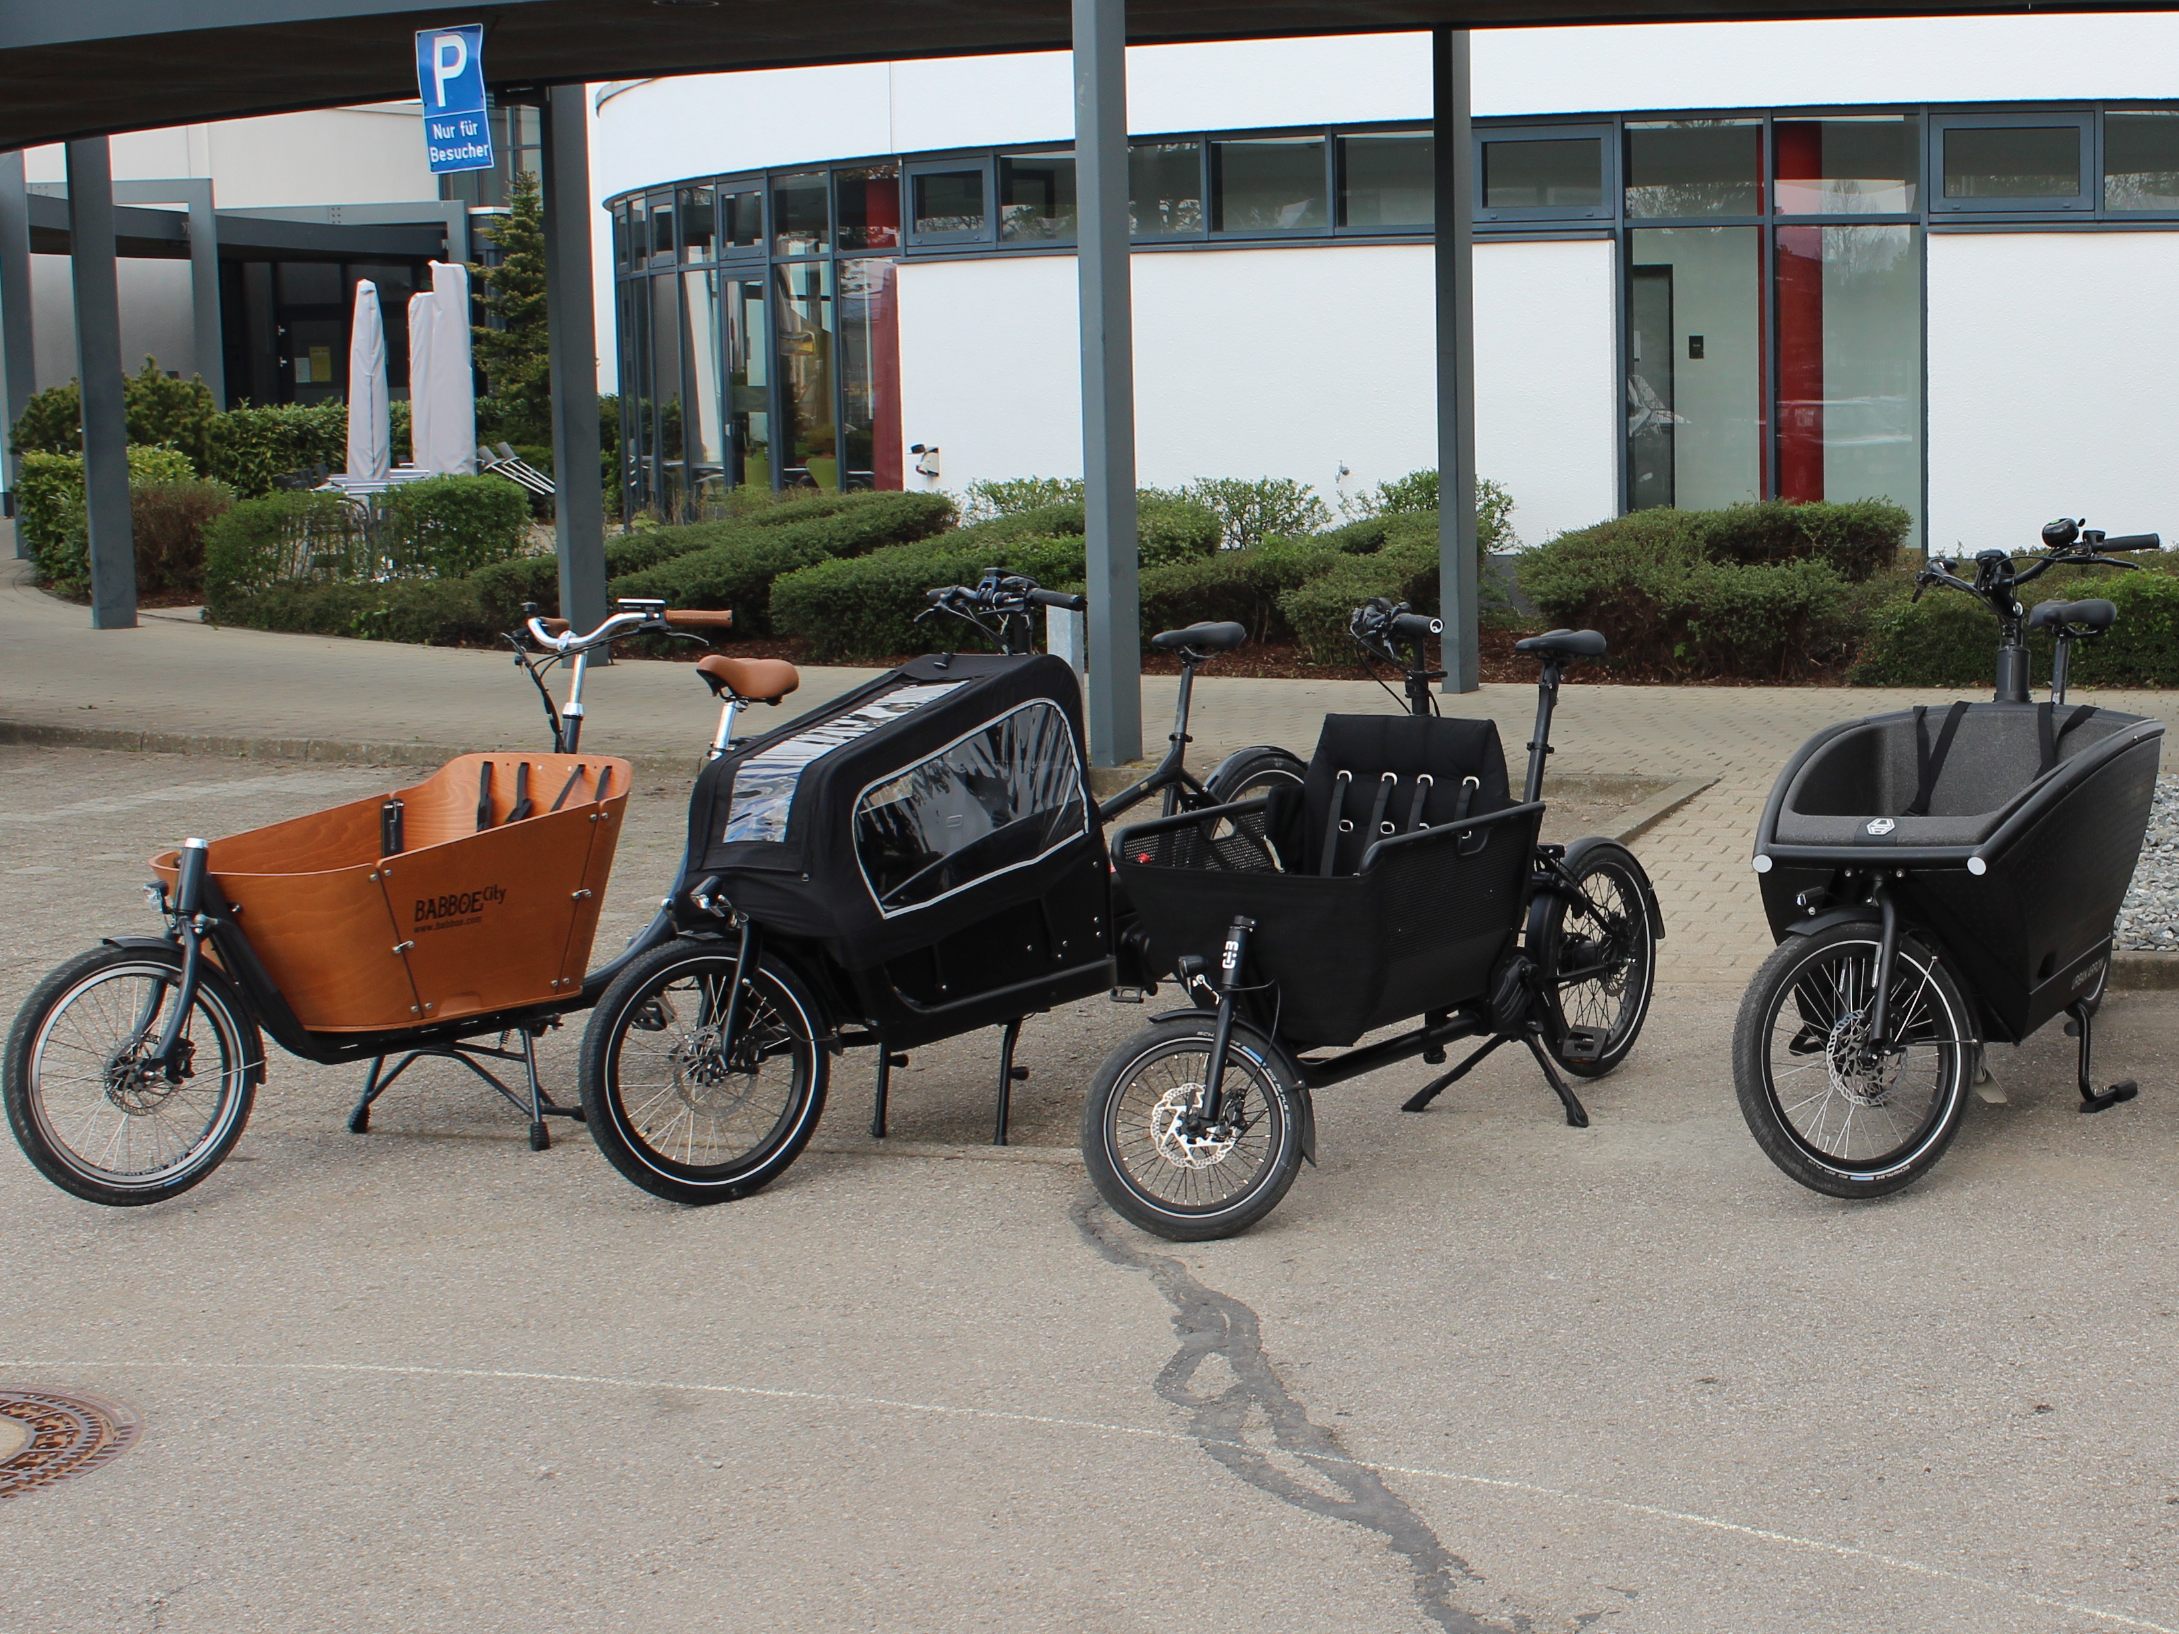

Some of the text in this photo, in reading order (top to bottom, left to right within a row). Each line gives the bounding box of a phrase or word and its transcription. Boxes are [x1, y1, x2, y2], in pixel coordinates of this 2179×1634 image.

[434, 34, 467, 108] P
[432, 120, 478, 140] Nur für
[430, 143, 489, 163] Besucher
